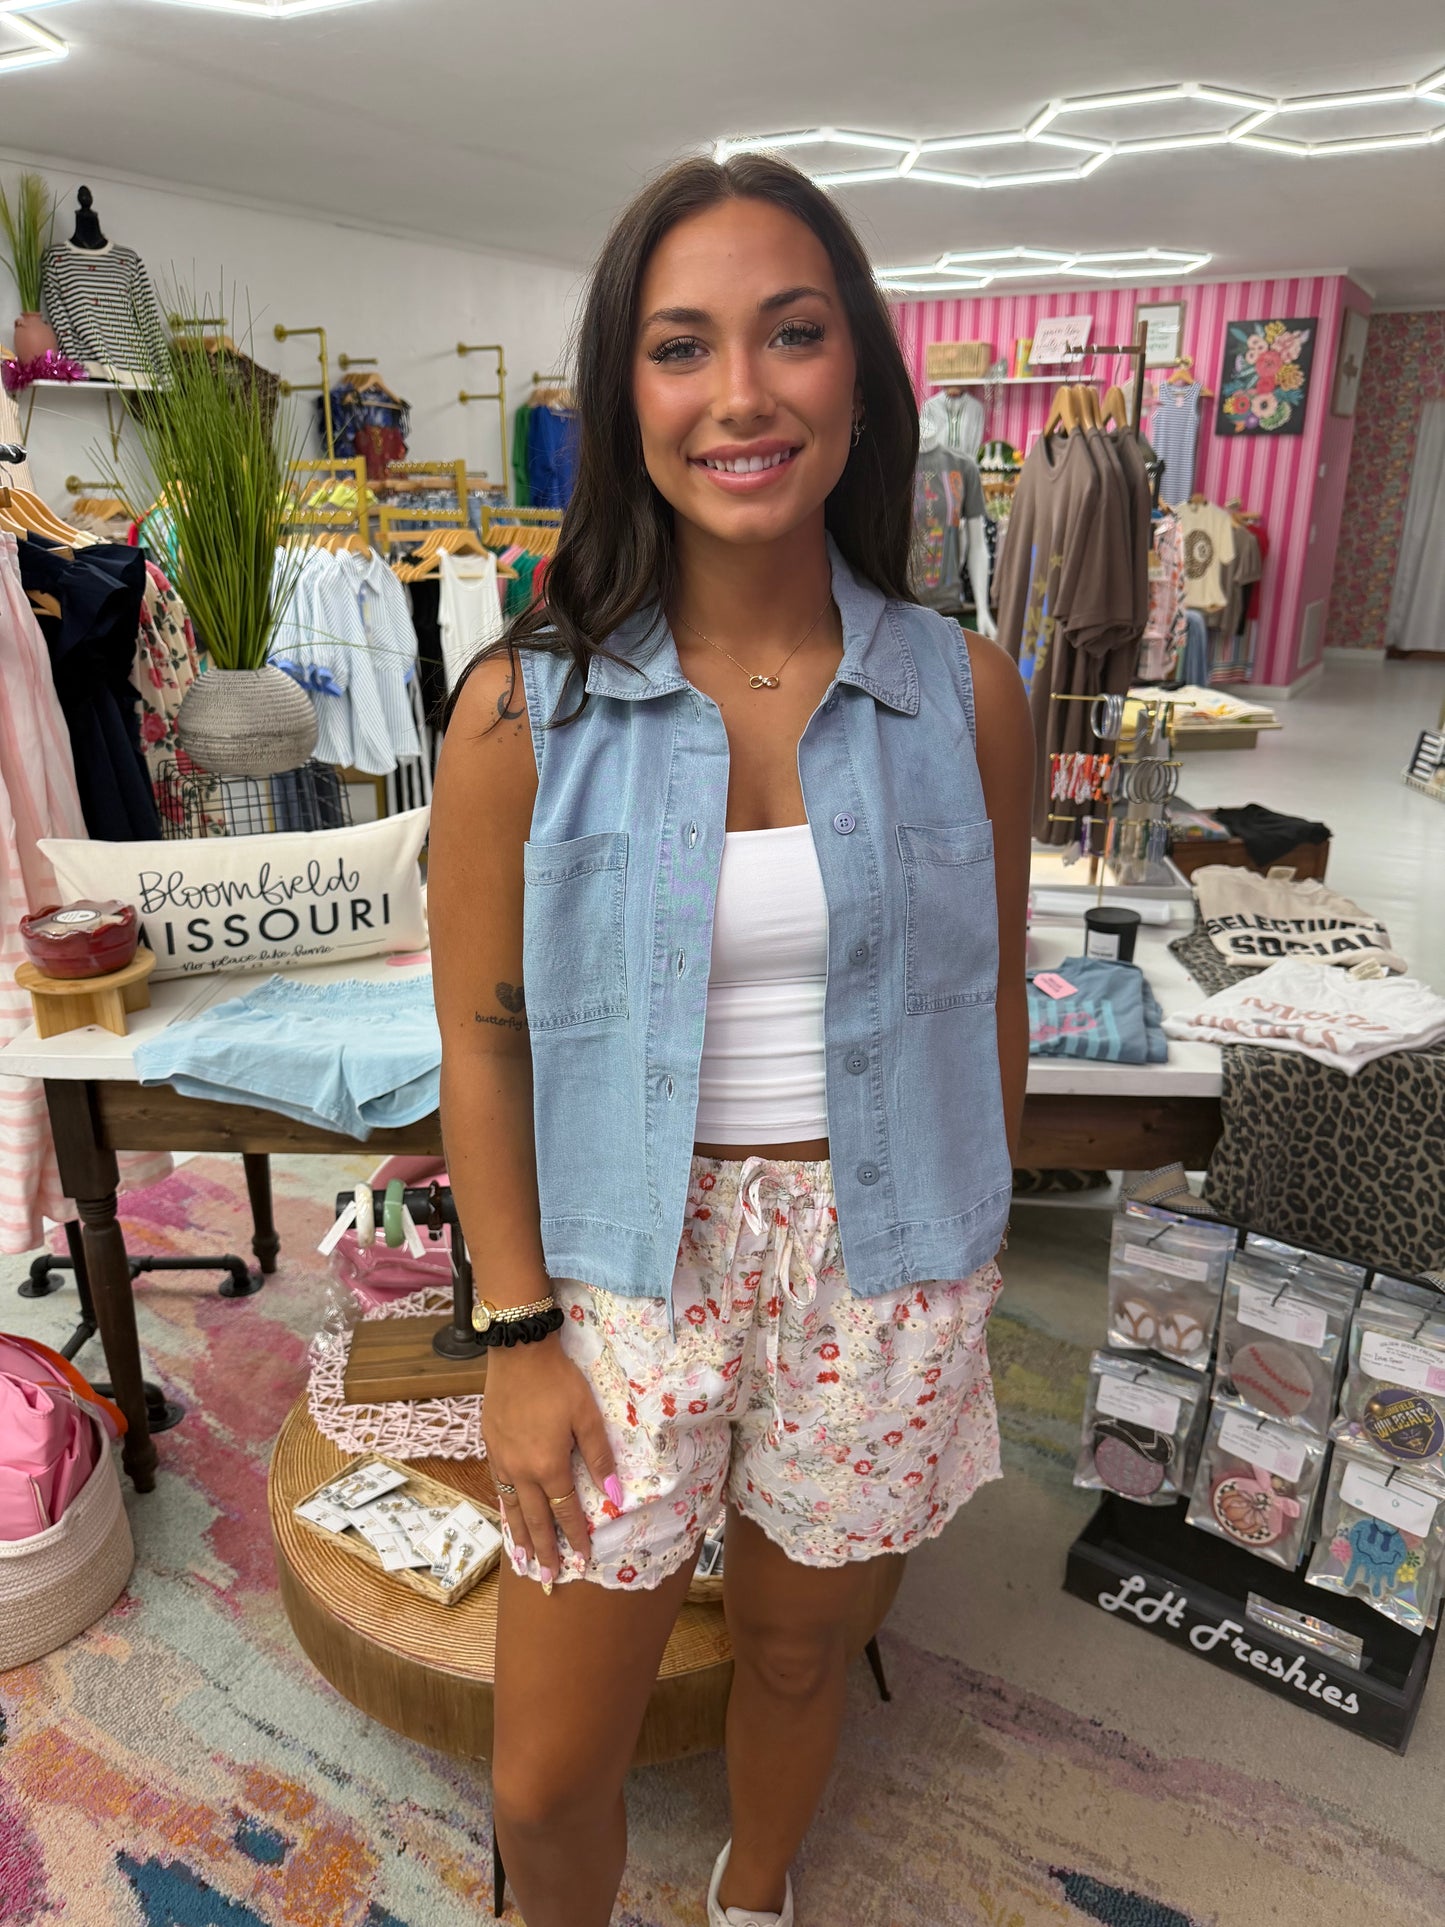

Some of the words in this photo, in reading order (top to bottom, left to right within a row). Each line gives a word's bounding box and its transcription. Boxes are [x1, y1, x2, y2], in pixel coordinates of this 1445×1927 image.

[138, 857, 360, 914] Bloomfield
[208, 953, 258, 970] place
[260, 949, 290, 961] like
[291, 944, 335, 958] home
[1098, 1575, 1188, 1628] LH
[1189, 1619, 1359, 1714] Freshies
